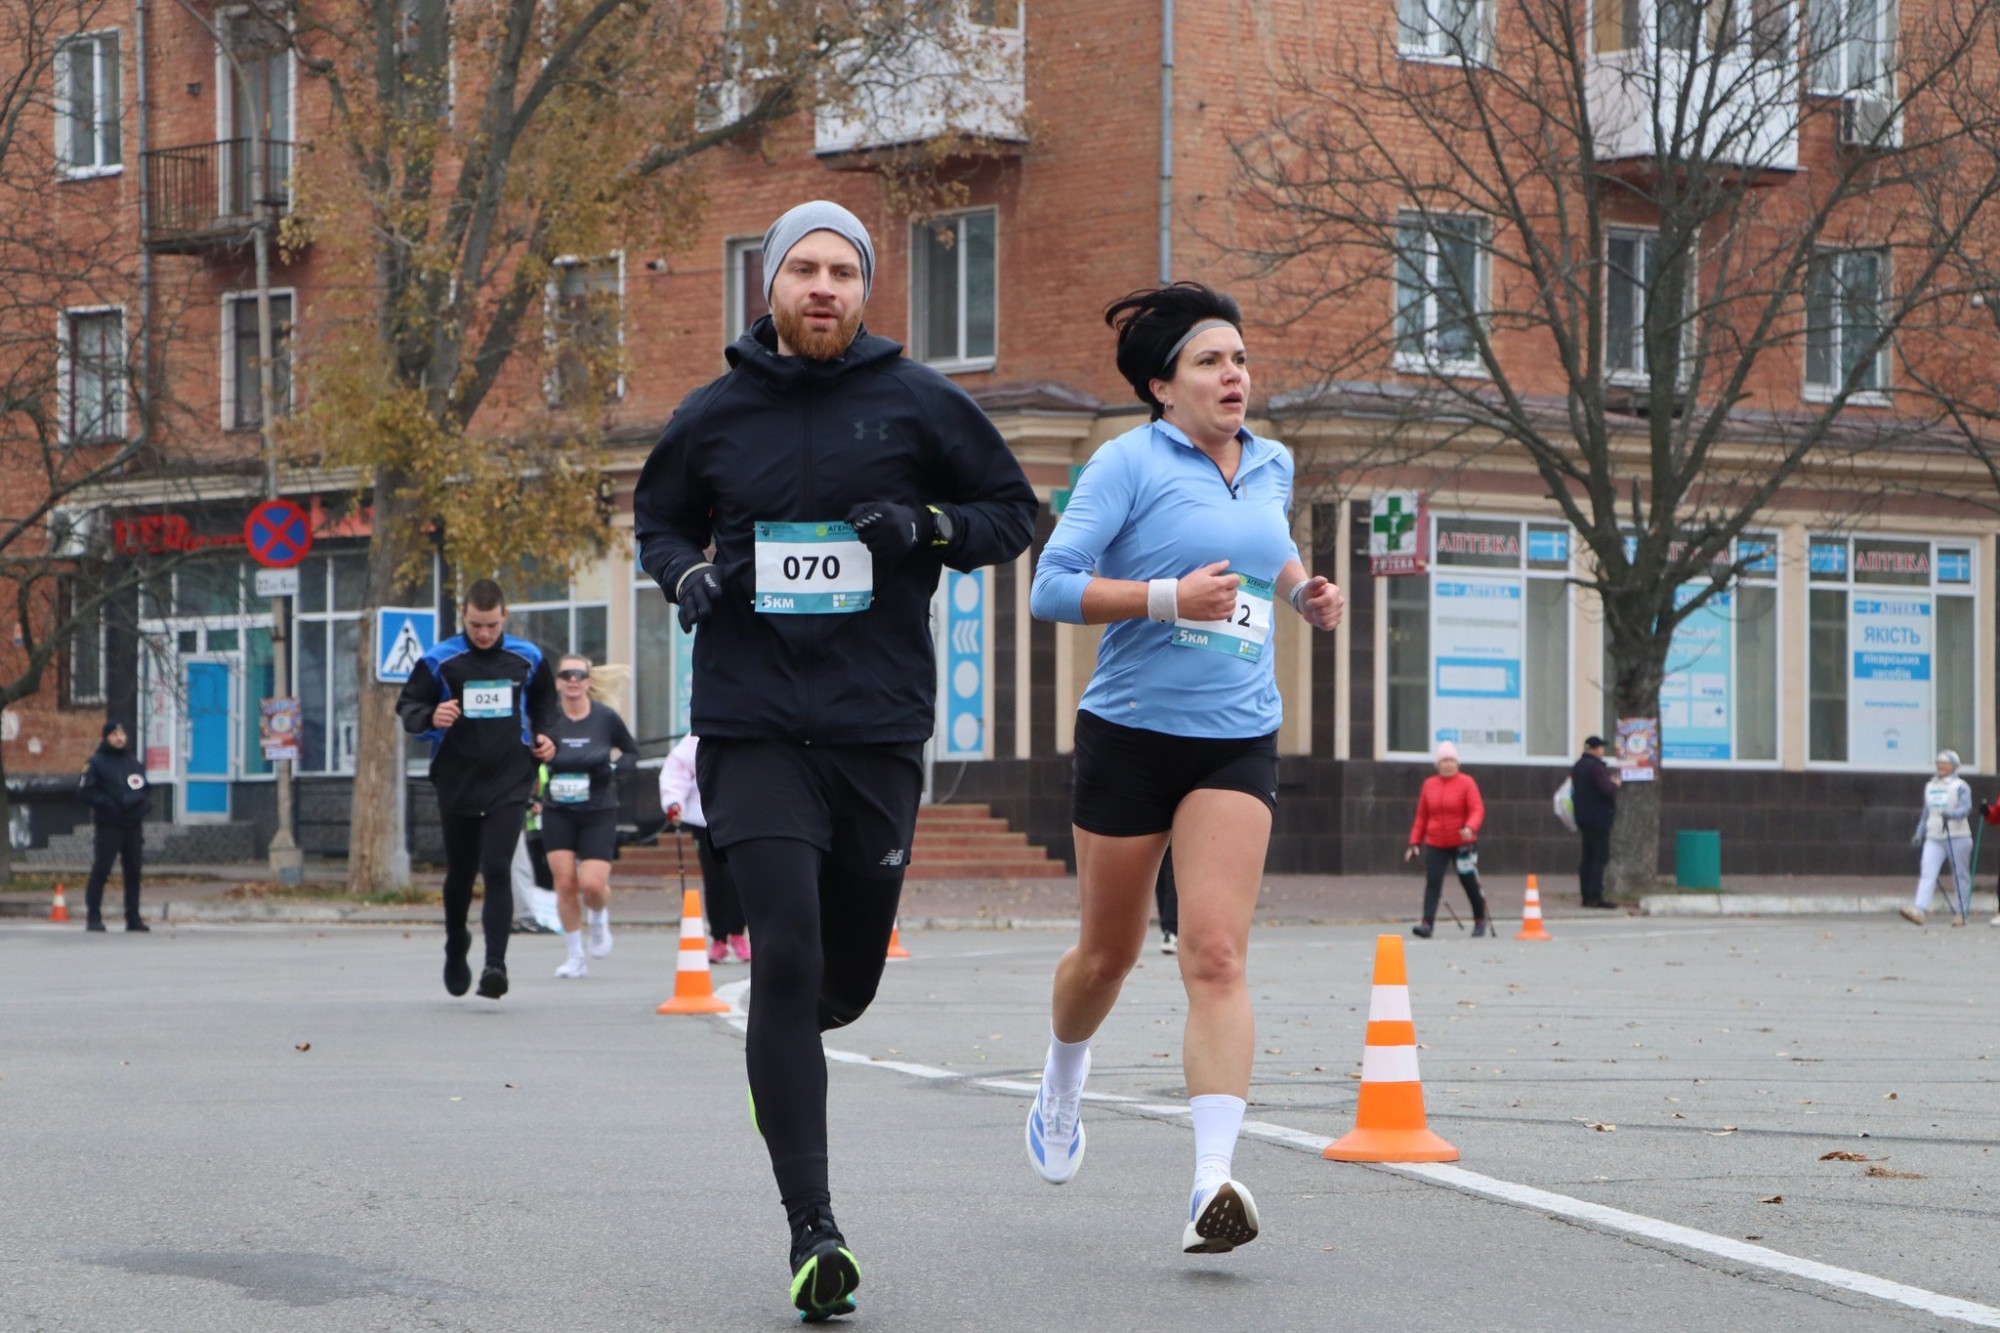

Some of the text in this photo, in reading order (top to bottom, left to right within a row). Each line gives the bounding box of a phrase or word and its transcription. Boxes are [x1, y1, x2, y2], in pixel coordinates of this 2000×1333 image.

[1437, 531, 1519, 555] АПТЕКА
[783, 555, 841, 580] 070
[1856, 551, 1930, 573] АПТЕКА
[1864, 626, 1921, 645] ЯКІСТЬ
[1863, 653, 1921, 667] лікарських
[475, 693, 499, 705] 024
